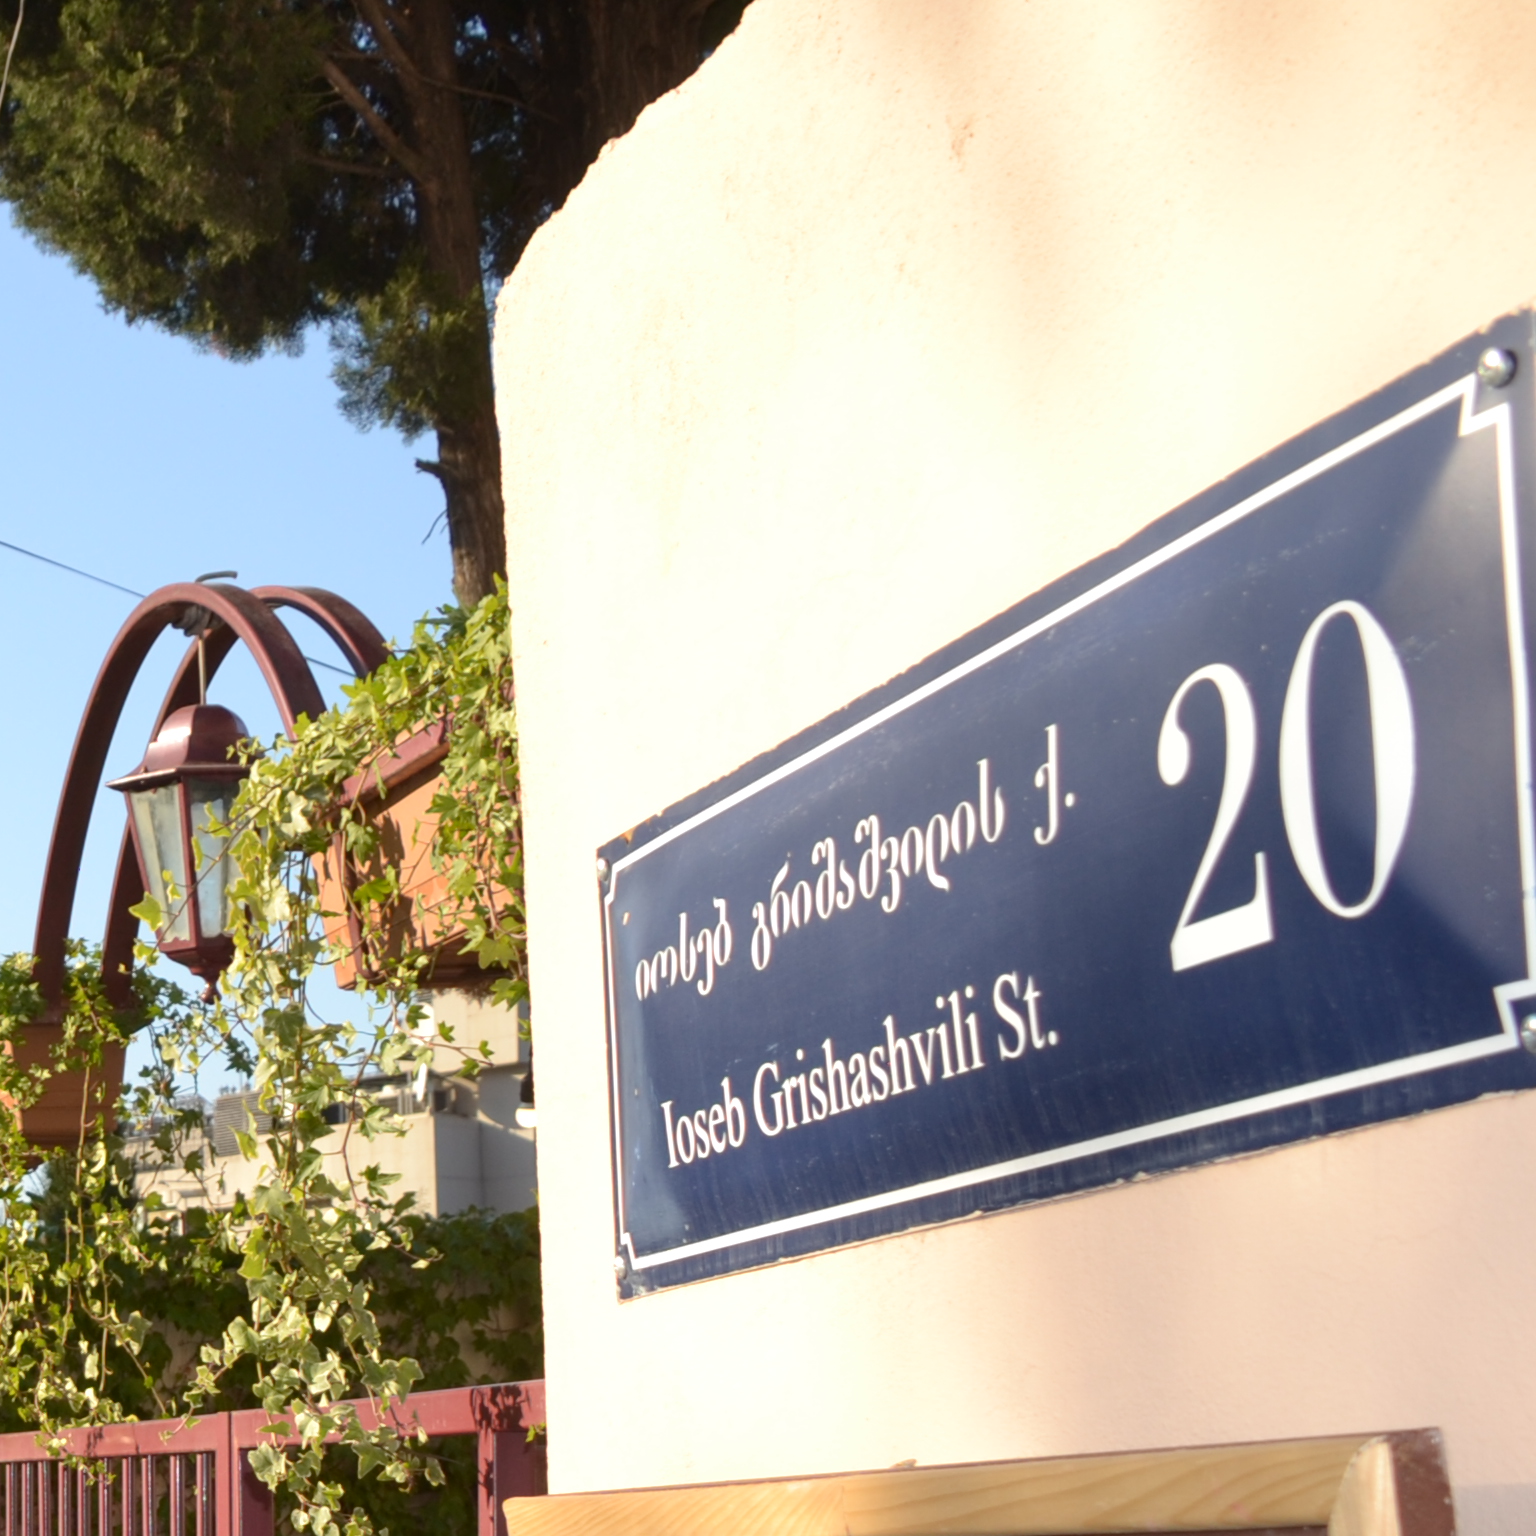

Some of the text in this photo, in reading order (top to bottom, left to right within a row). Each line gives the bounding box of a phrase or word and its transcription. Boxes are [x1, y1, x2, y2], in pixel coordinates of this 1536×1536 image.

[634, 896, 733, 1002] იოსებ
[750, 757, 1007, 972] გრიშაშვილის
[1156, 598, 1416, 973] 20
[660, 970, 1061, 1169] Ioseb Grishashvili St.
